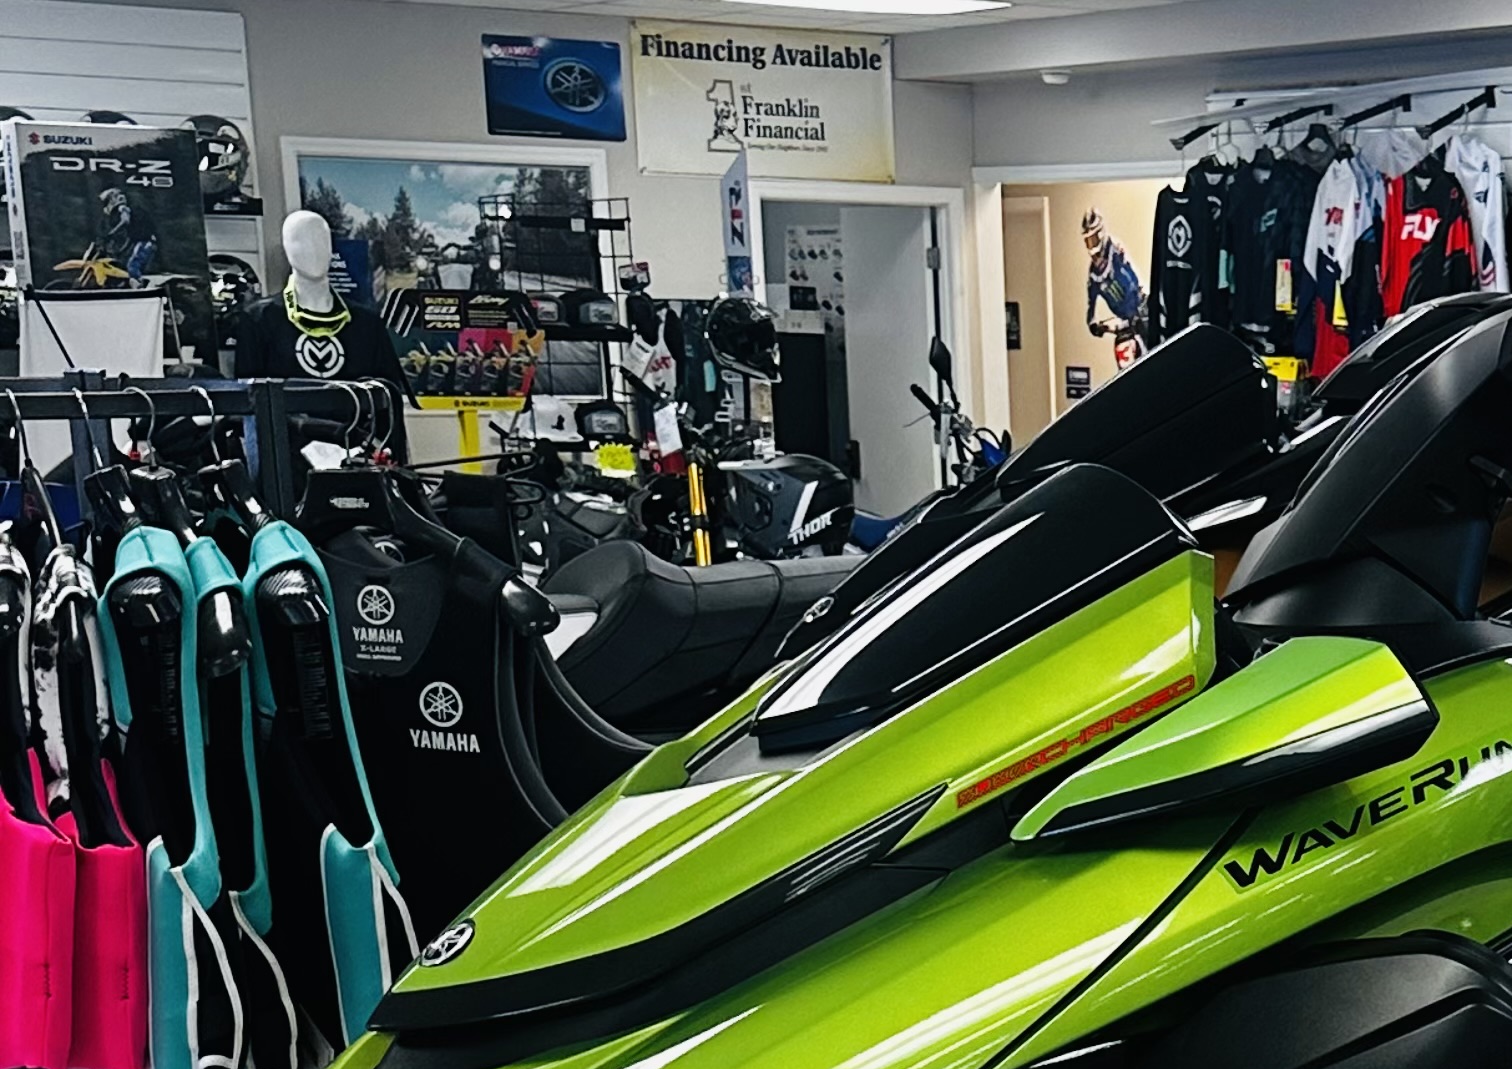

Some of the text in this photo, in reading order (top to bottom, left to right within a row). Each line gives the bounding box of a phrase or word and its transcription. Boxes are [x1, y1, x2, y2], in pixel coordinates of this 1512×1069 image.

[639, 34, 883, 71] Financing Available
[741, 95, 820, 119] Franklin
[43, 135, 93, 146] SUZUKI
[743, 117, 826, 141] Financial
[50, 156, 172, 174] DR-Z
[1400, 213, 1441, 241] FLY
[787, 510, 833, 545] THOR
[352, 626, 404, 644] YAMAHA
[409, 729, 480, 753] YAMAHA
